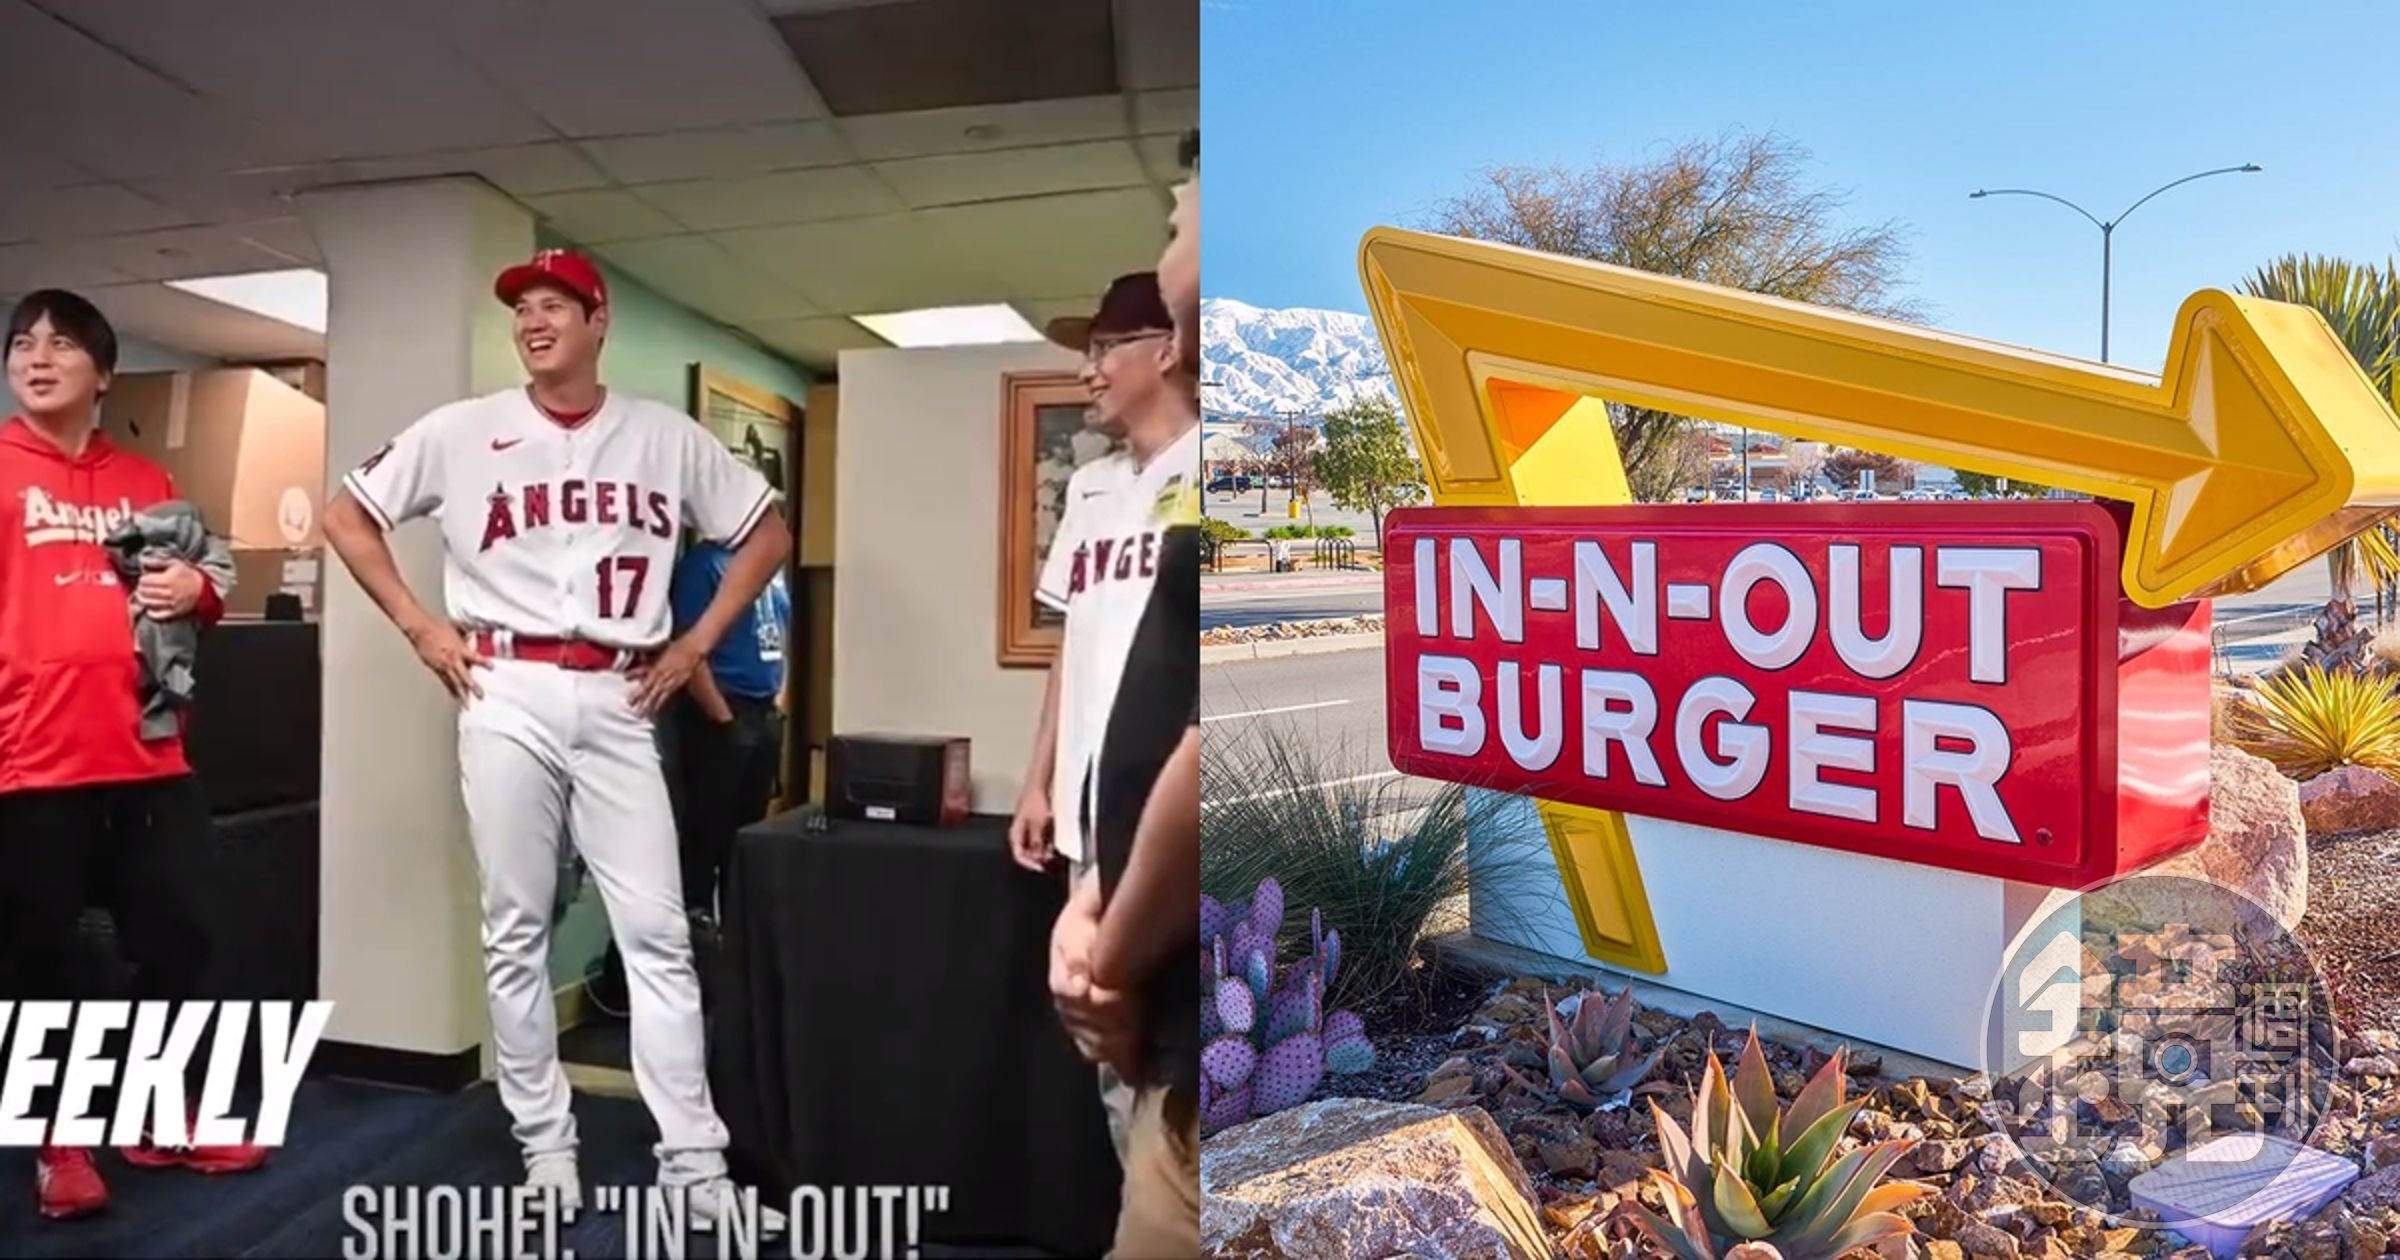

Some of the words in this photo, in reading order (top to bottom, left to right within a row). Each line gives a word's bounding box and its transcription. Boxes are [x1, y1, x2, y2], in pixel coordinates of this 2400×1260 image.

[24, 485, 133, 545] Angel
[480, 480, 672, 553] ANGELS
[596, 556, 649, 619] 17
[1066, 532, 1156, 600] ANGE
[1414, 537, 2041, 684] IN-N-OUT
[1416, 653, 2022, 845] BURGER
